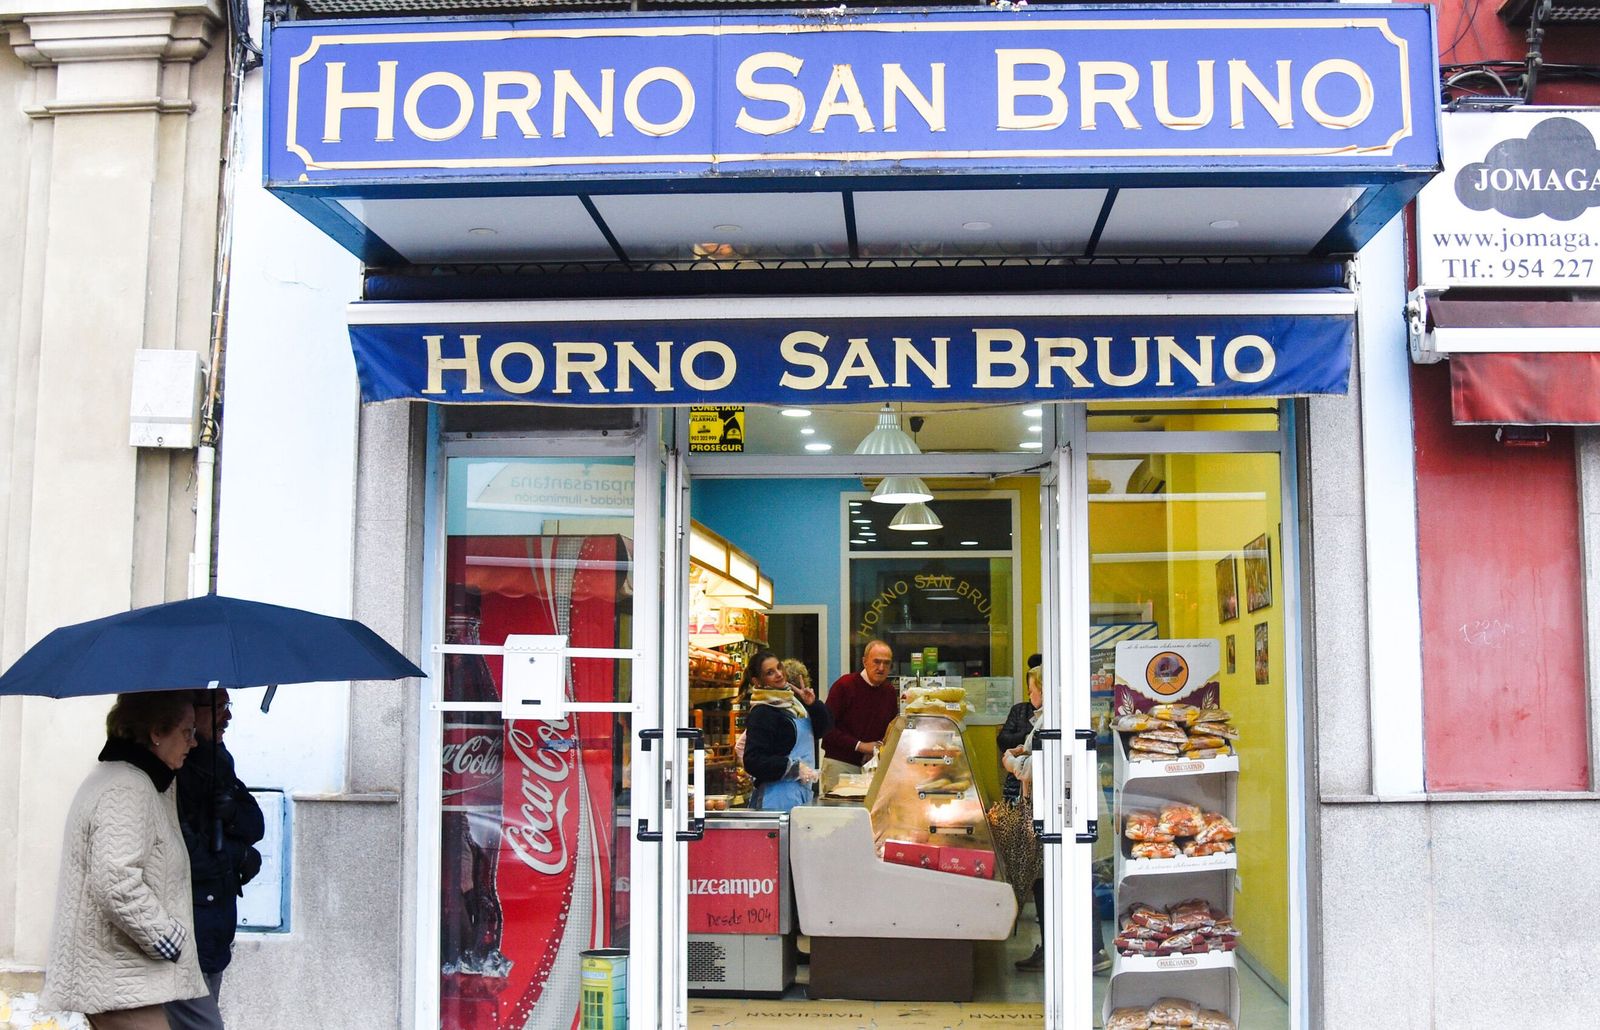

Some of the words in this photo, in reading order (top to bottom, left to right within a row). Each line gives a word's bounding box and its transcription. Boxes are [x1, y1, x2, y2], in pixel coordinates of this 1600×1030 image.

[322, 60, 696, 143] HORNO
[734, 51, 947, 135] SAN
[994, 48, 1375, 132] BRUNO
[1474, 168, 1600, 191] JOMAGA
[1442, 259, 1493, 278] Tlf.:
[1502, 259, 1544, 278] 954
[1553, 259, 1594, 278] 227
[421, 334, 738, 395] HORNO
[779, 330, 952, 391] SAN
[971, 328, 1277, 389] BRUNO
[857, 580, 908, 637] HORNO
[914, 575, 952, 589] SAN
[706, 909, 742, 927] Desde
[747, 908, 771, 924] 1904
